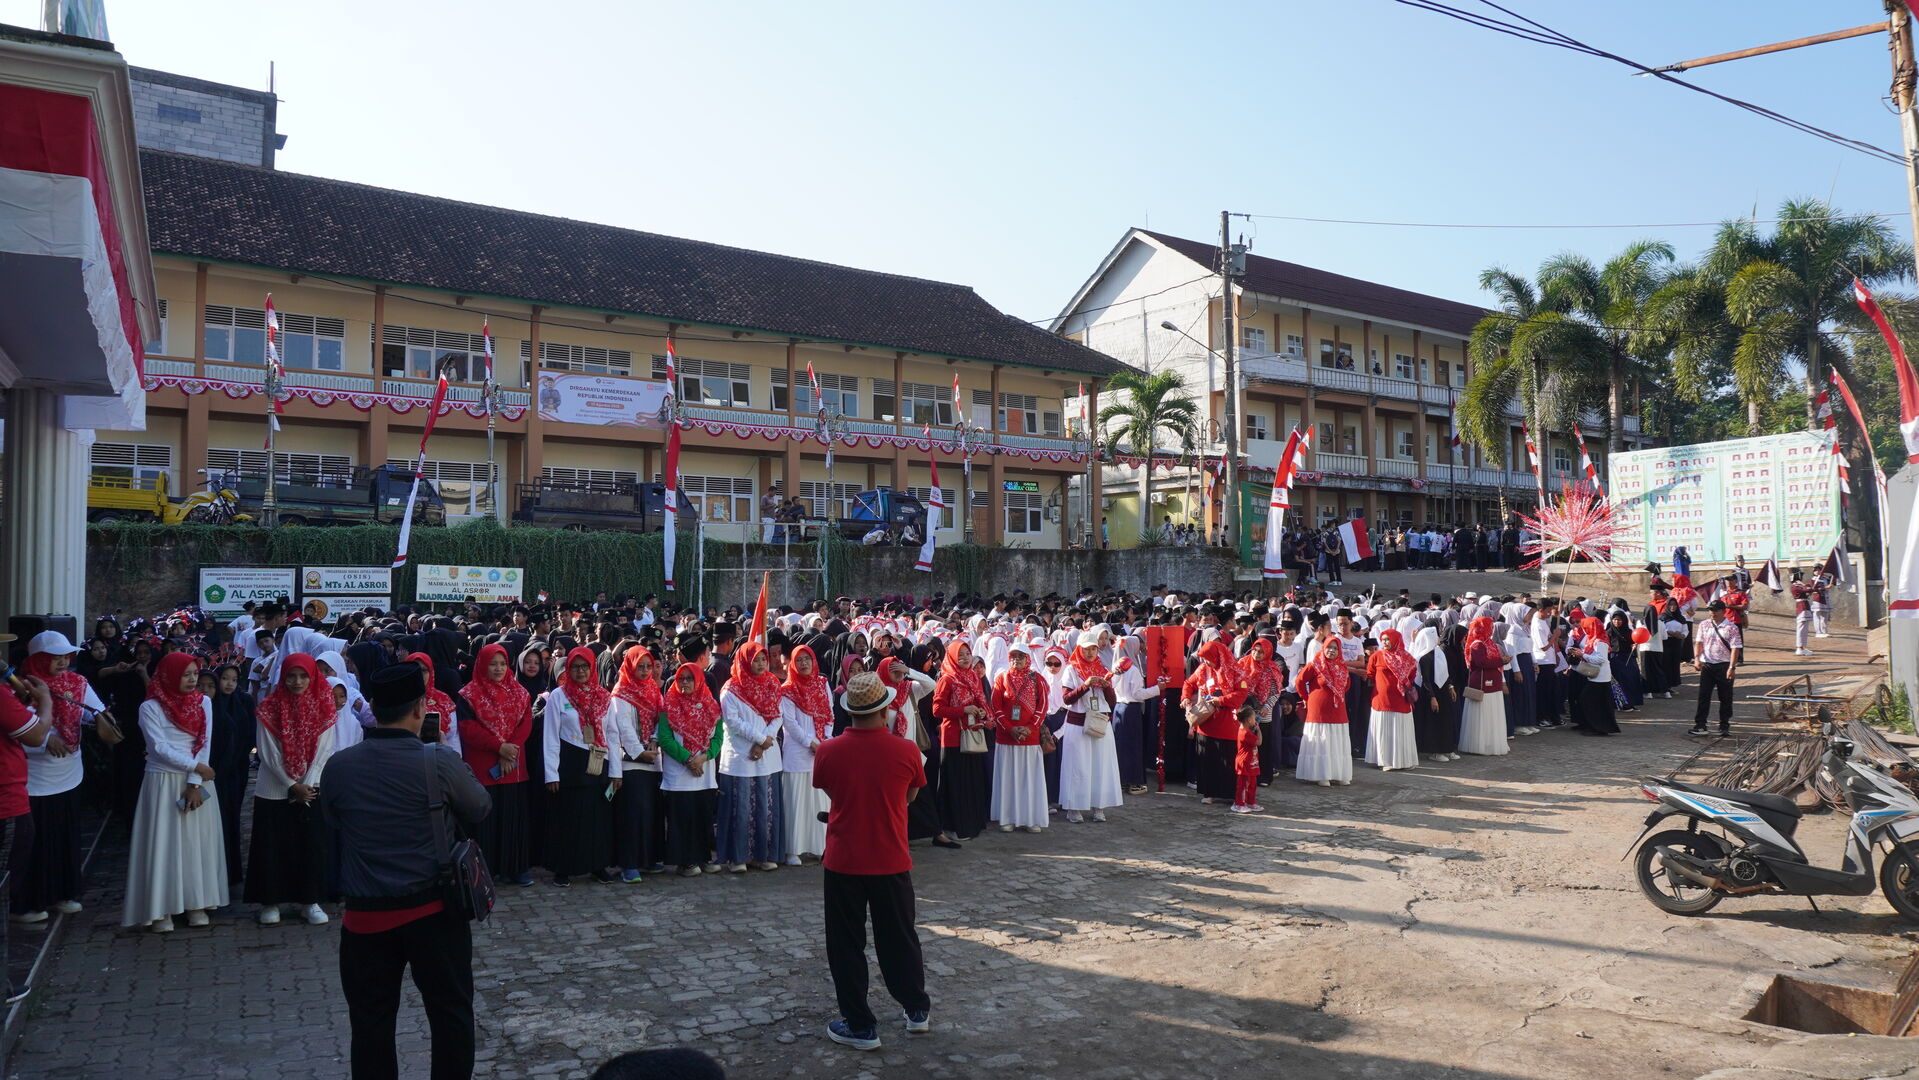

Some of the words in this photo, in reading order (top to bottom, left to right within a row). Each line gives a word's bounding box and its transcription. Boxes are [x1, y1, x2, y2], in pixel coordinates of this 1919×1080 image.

[569, 385, 600, 393] DIRGAHAYU
[230, 590, 246, 599] AL
[419, 593, 465, 601] MADRASAH
